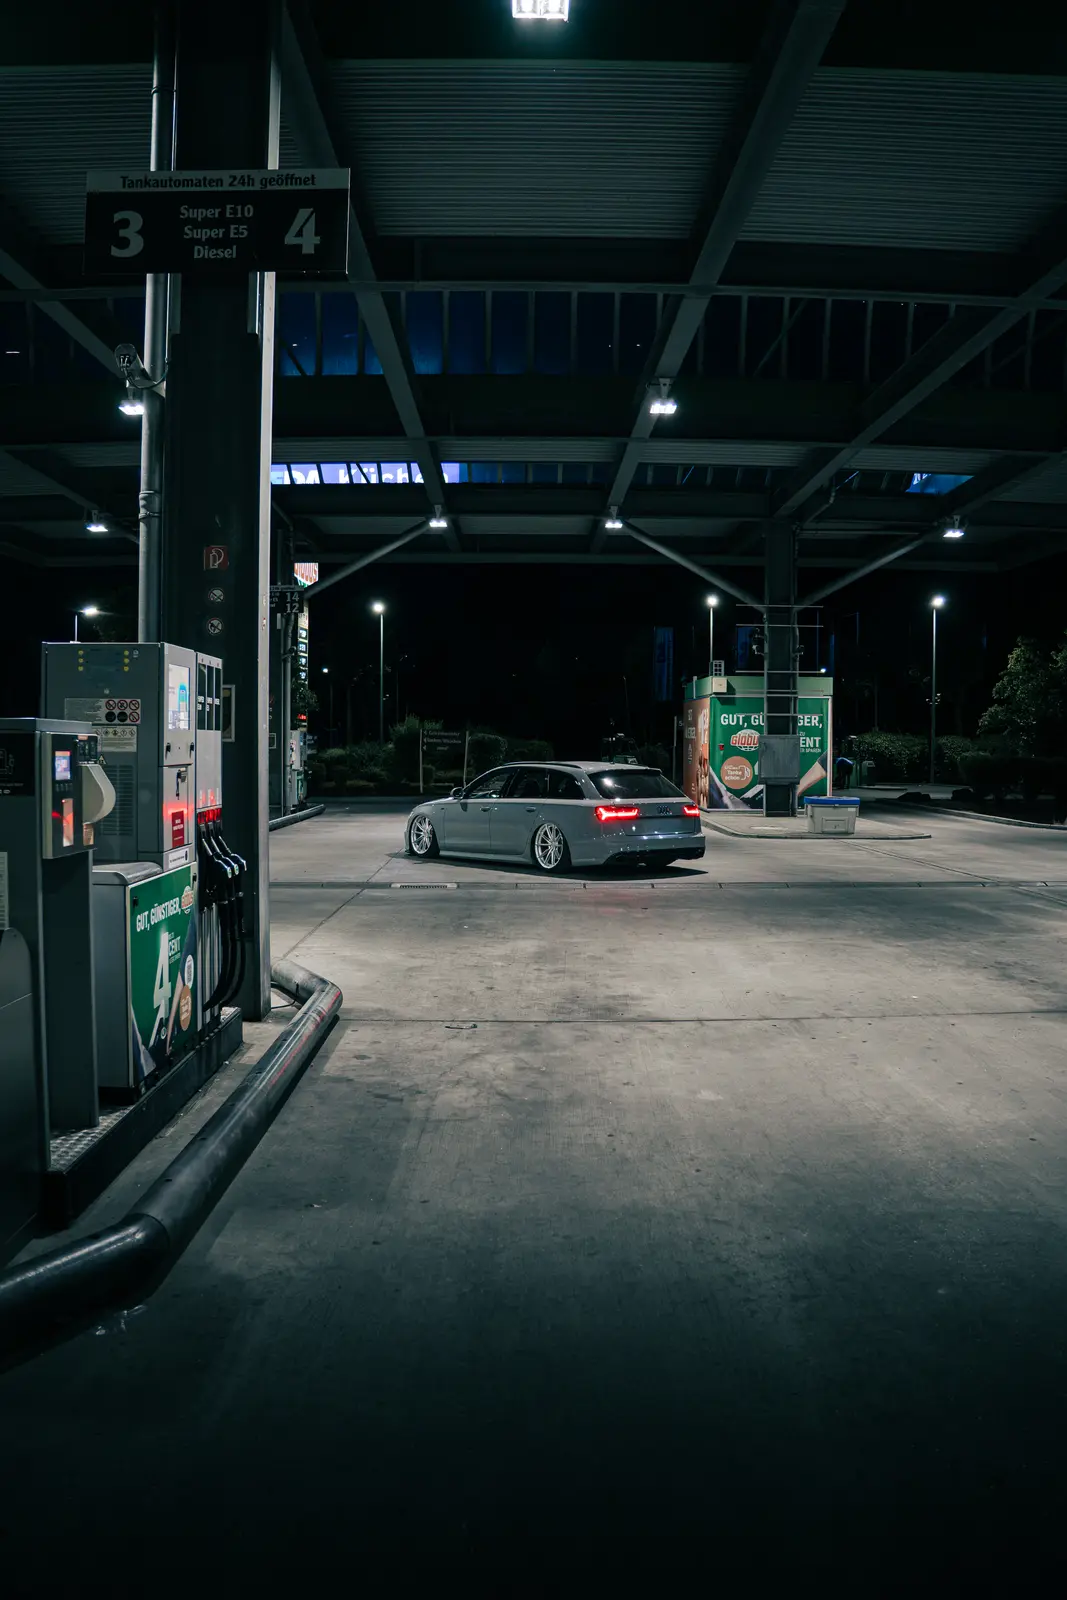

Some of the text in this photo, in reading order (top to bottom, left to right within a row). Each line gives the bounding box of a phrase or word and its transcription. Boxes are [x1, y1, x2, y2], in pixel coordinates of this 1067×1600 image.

[121, 174, 316, 190] Tankautomaten 24h geöffnet
[179, 204, 254, 222] Super E10
[110, 210, 144, 259] 3
[183, 225, 249, 242] Super E5
[284, 208, 321, 255] 4
[193, 245, 237, 259] Diesel
[285, 591, 300, 602] 14
[285, 602, 300, 613] 12
[720, 713, 748, 728] GUT,
[799, 737, 822, 748] ENT
[136, 910, 150, 933] GUT,
[150, 896, 182, 924] GÜNSTIGER,
[153, 931, 172, 1018] 4
[168, 936, 181, 957] CENT
